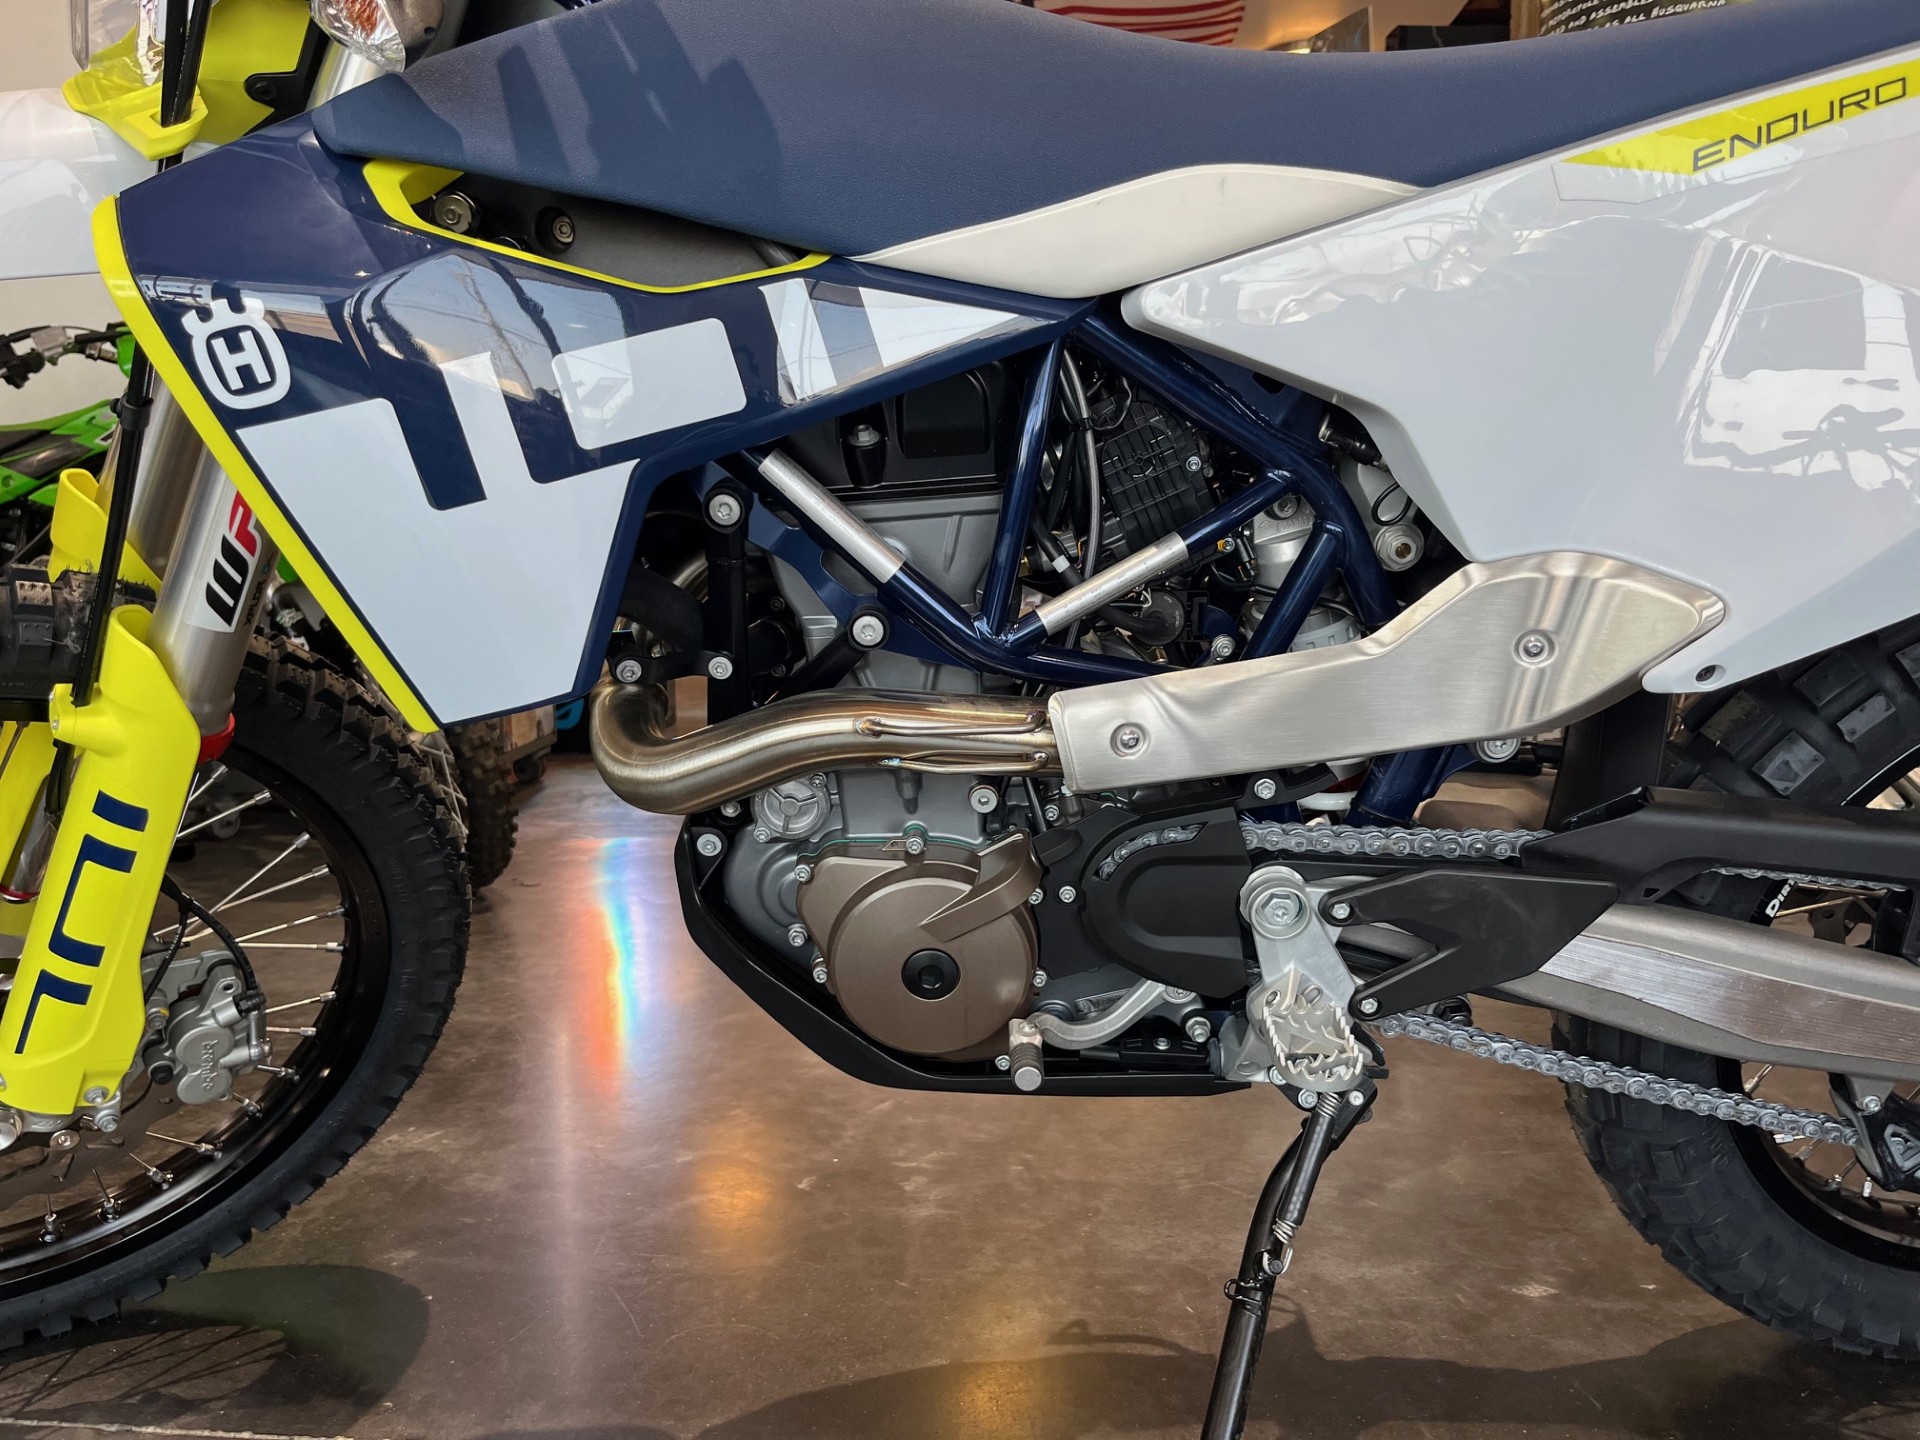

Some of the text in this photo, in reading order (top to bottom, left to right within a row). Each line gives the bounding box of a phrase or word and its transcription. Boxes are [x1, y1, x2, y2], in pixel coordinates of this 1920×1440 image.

[1567, 15, 1587, 29] AND
[1623, 12, 1646, 24] ALL
[1650, 0, 1726, 19] HUSQVARNA
[1693, 77, 1907, 172] ENDURO
[205, 490, 258, 627] WP
[201, 1039, 219, 1090] brembo
